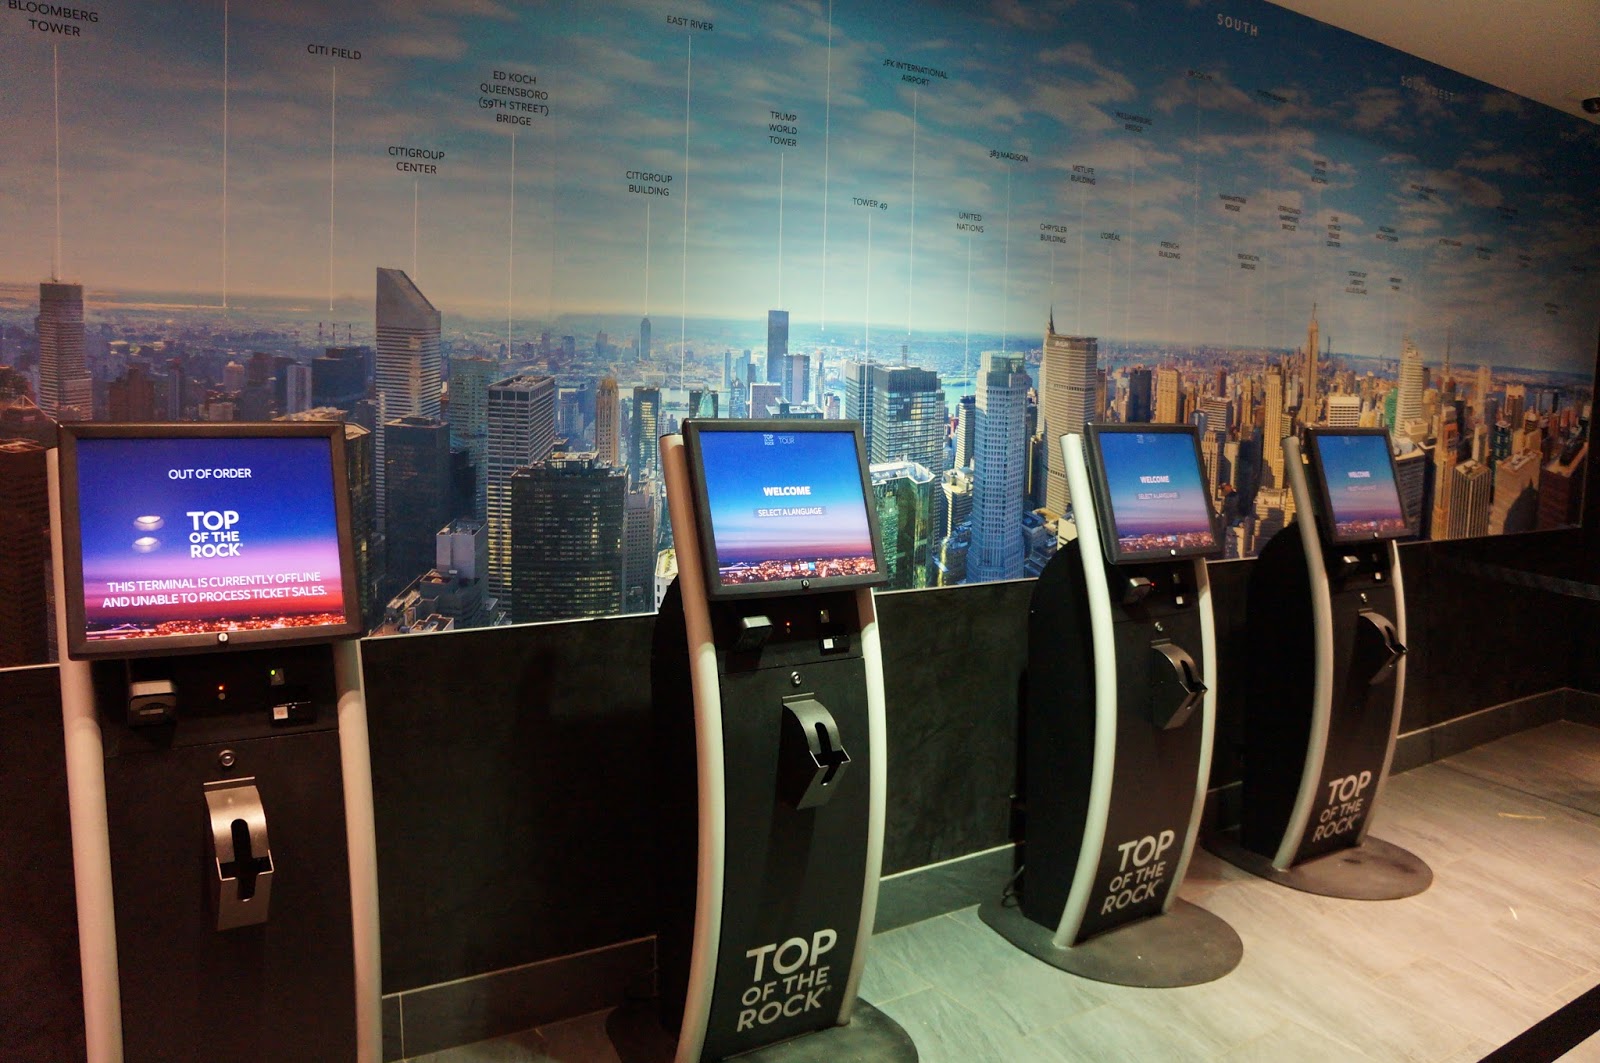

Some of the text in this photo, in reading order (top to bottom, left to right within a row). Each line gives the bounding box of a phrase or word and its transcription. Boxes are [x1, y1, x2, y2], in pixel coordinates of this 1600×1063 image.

[8, 0, 99, 22] BLOOMBERG
[28, 19, 81, 37] TOWER
[666, 15, 714, 32] EAST RIVER
[1217, 13, 1258, 37] SOUTH
[307, 44, 362, 60] CITI FIELD
[883, 58, 948, 80] JFK INTERNATIONAL
[493, 70, 537, 85] ED KOCH
[901, 74, 930, 87] AIRPORT
[480, 82, 549, 101] QUEENSBORO
[478, 97, 550, 117] (59TH STREET)
[496, 113, 532, 127] BRIDGE
[770, 111, 797, 122] TRUMP
[769, 123, 797, 135] WORLD
[769, 136, 797, 147] TOWER
[388, 146, 445, 160] CITIGROUP
[989, 150, 1029, 162] 383 MADISON
[396, 161, 437, 175] CENTER
[1072, 164, 1095, 175] METLIFE
[626, 170, 673, 184] CITIGROUP
[1070, 174, 1096, 185] BUILDING
[628, 184, 670, 197] BUILDING
[852, 197, 888, 210] TOWER 49
[958, 211, 982, 222] UNITED
[956, 223, 984, 233] NATIONS
[1040, 223, 1067, 233] CHRYSLER
[1040, 234, 1066, 244] BUILDING
[1160, 241, 1179, 250] FRENCH
[1158, 250, 1180, 260] BUILDING
[168, 468, 252, 480] OUT OF ORDER
[1139, 475, 1170, 484] WELCOME
[763, 486, 811, 497] WELCOME
[758, 507, 823, 517] SELECT A LANGUAGE
[186, 510, 240, 531] TOP
[189, 531, 240, 544] OF THE
[190, 543, 241, 558] ROCK
[107, 571, 321, 593] THIS TERMINAL IS CURRENTLY OFFLINE
[102, 585, 328, 608] AND UNABLE TO PROCESS TICKET SALES.
[1328, 770, 1372, 805] TOP
[1320, 798, 1364, 823] OF THE
[1312, 814, 1358, 843] ROCK
[1118, 830, 1175, 872] TOP
[1109, 861, 1167, 893] OF THE
[1101, 880, 1160, 915] ROCK
[746, 928, 838, 982] TOP
[741, 966, 830, 1006] OF THE
[736, 986, 826, 1032] ROCK
